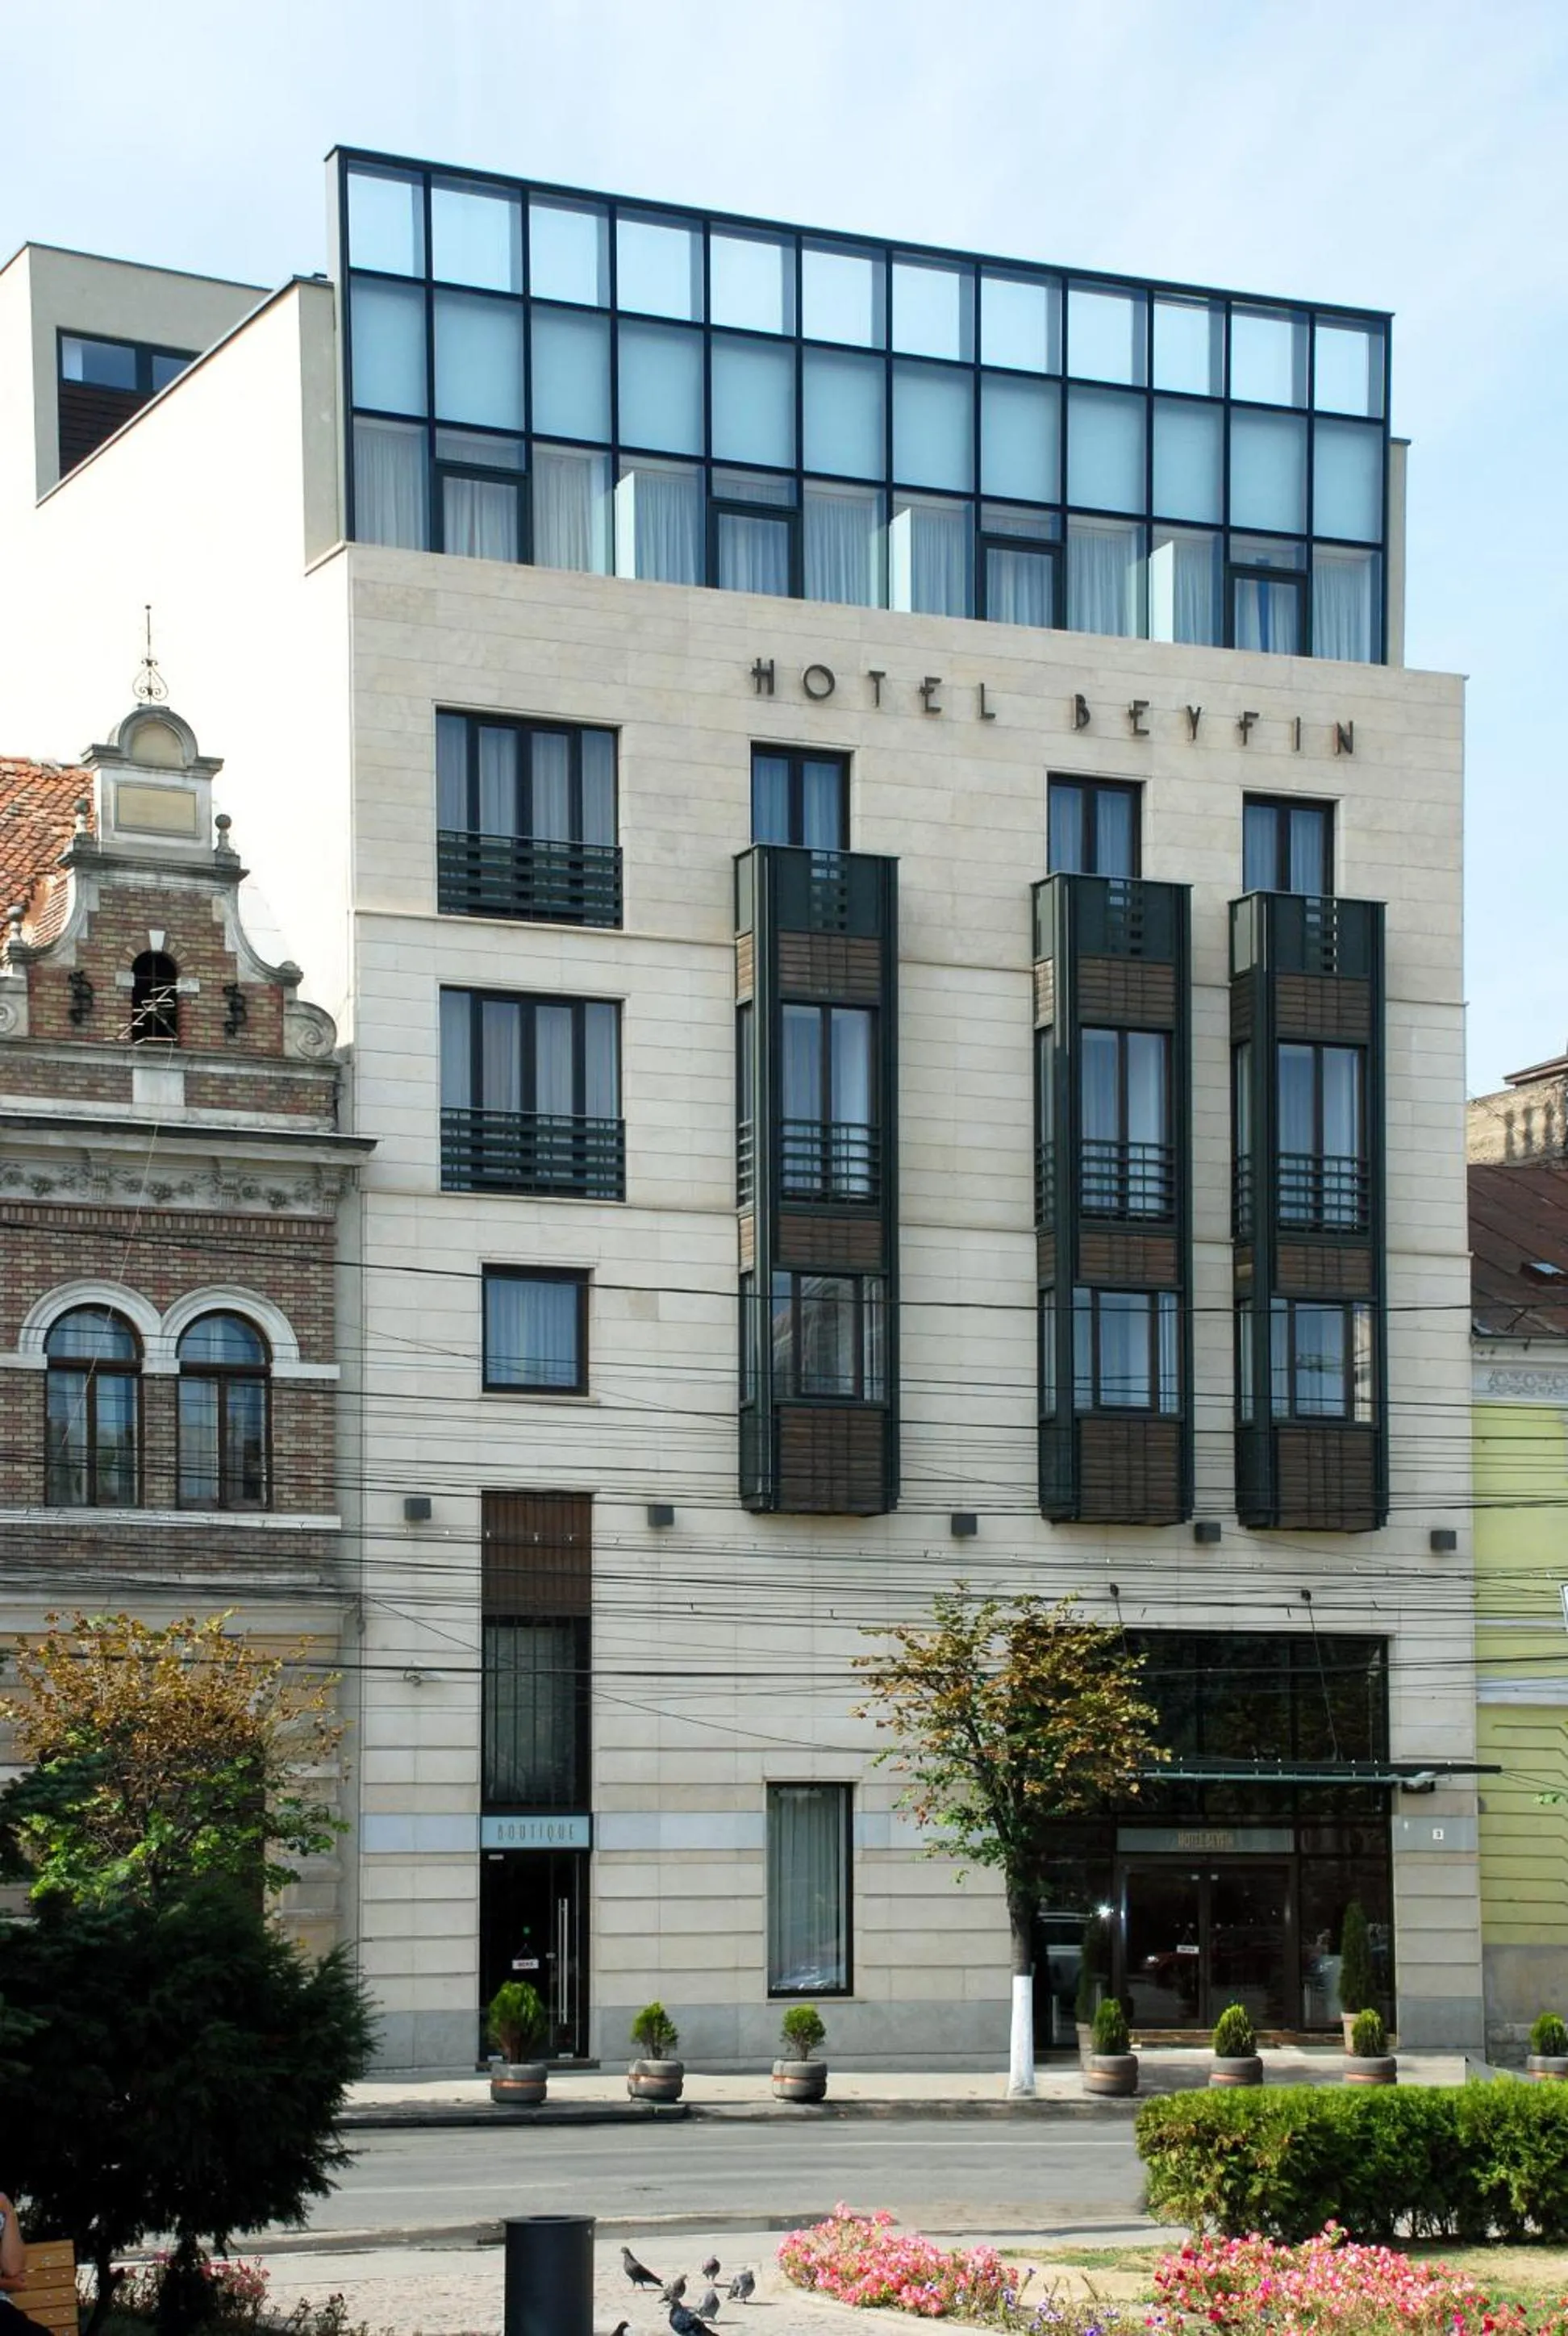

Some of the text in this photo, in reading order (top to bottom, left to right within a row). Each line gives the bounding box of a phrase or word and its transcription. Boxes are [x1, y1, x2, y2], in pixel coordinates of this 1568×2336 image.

[751, 657, 1354, 756] HOTEL BEYFIN
[497, 1822, 574, 1843] BOUTIQUE
